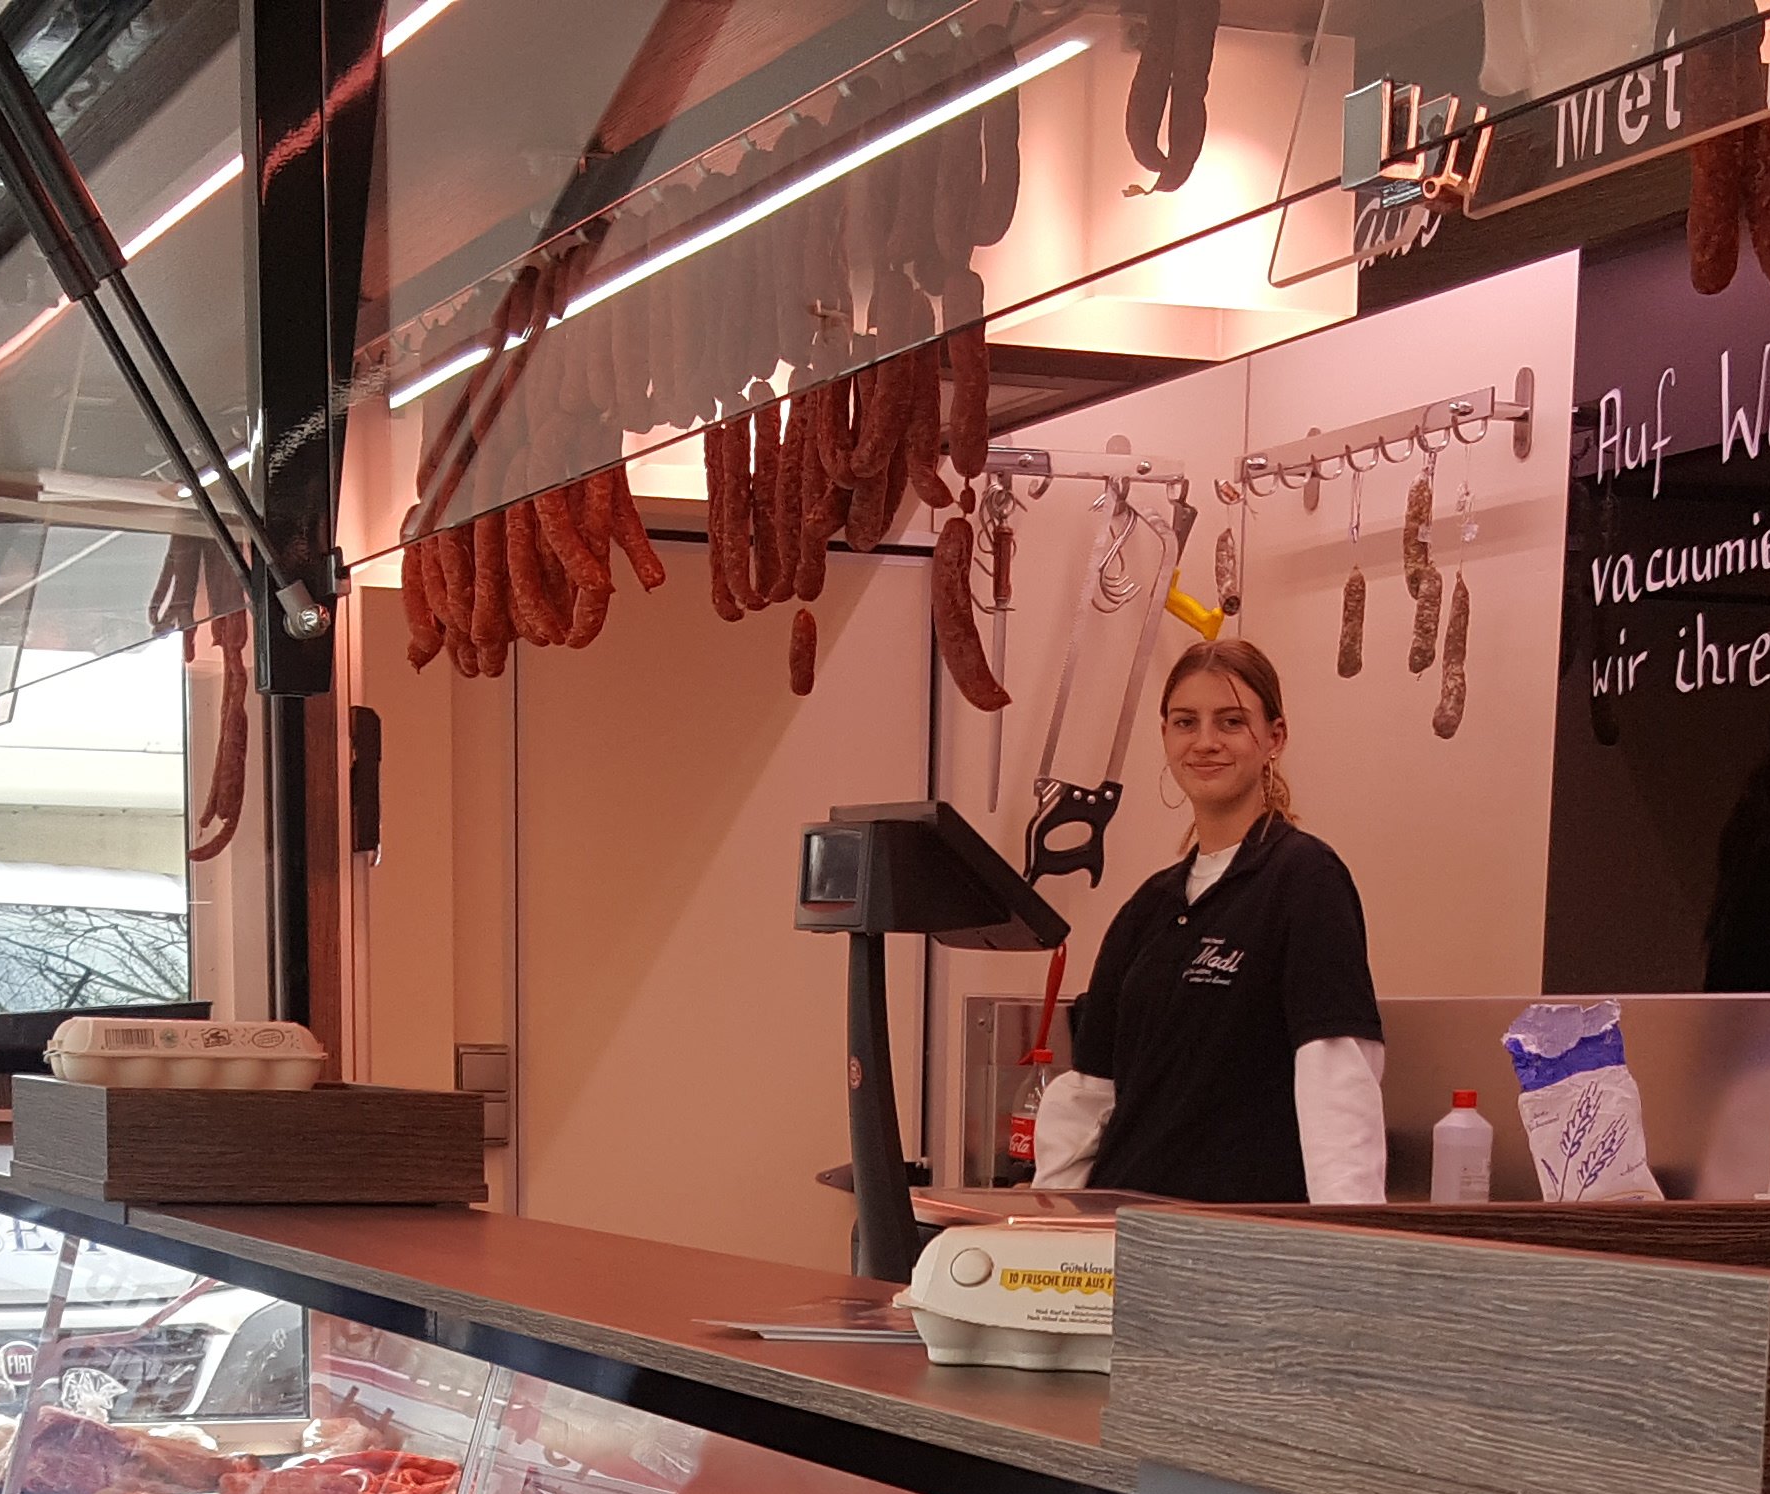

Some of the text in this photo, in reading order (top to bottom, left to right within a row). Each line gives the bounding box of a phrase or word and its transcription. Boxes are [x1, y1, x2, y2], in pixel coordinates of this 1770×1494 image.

[1597, 367, 1676, 500] Auf
[1592, 628, 1648, 697] wir
[1191, 945, 1245, 973] Madl
[1008, 1272, 1018, 1284] 10
[1021, 1273, 1061, 1286] FRISCHE
[1062, 1275, 1083, 1287] EIER
[1086, 1277, 1104, 1289] AUS
[1060, 1262, 1113, 1275] Güteklasse
[7, 1353, 34, 1374] FIAT
